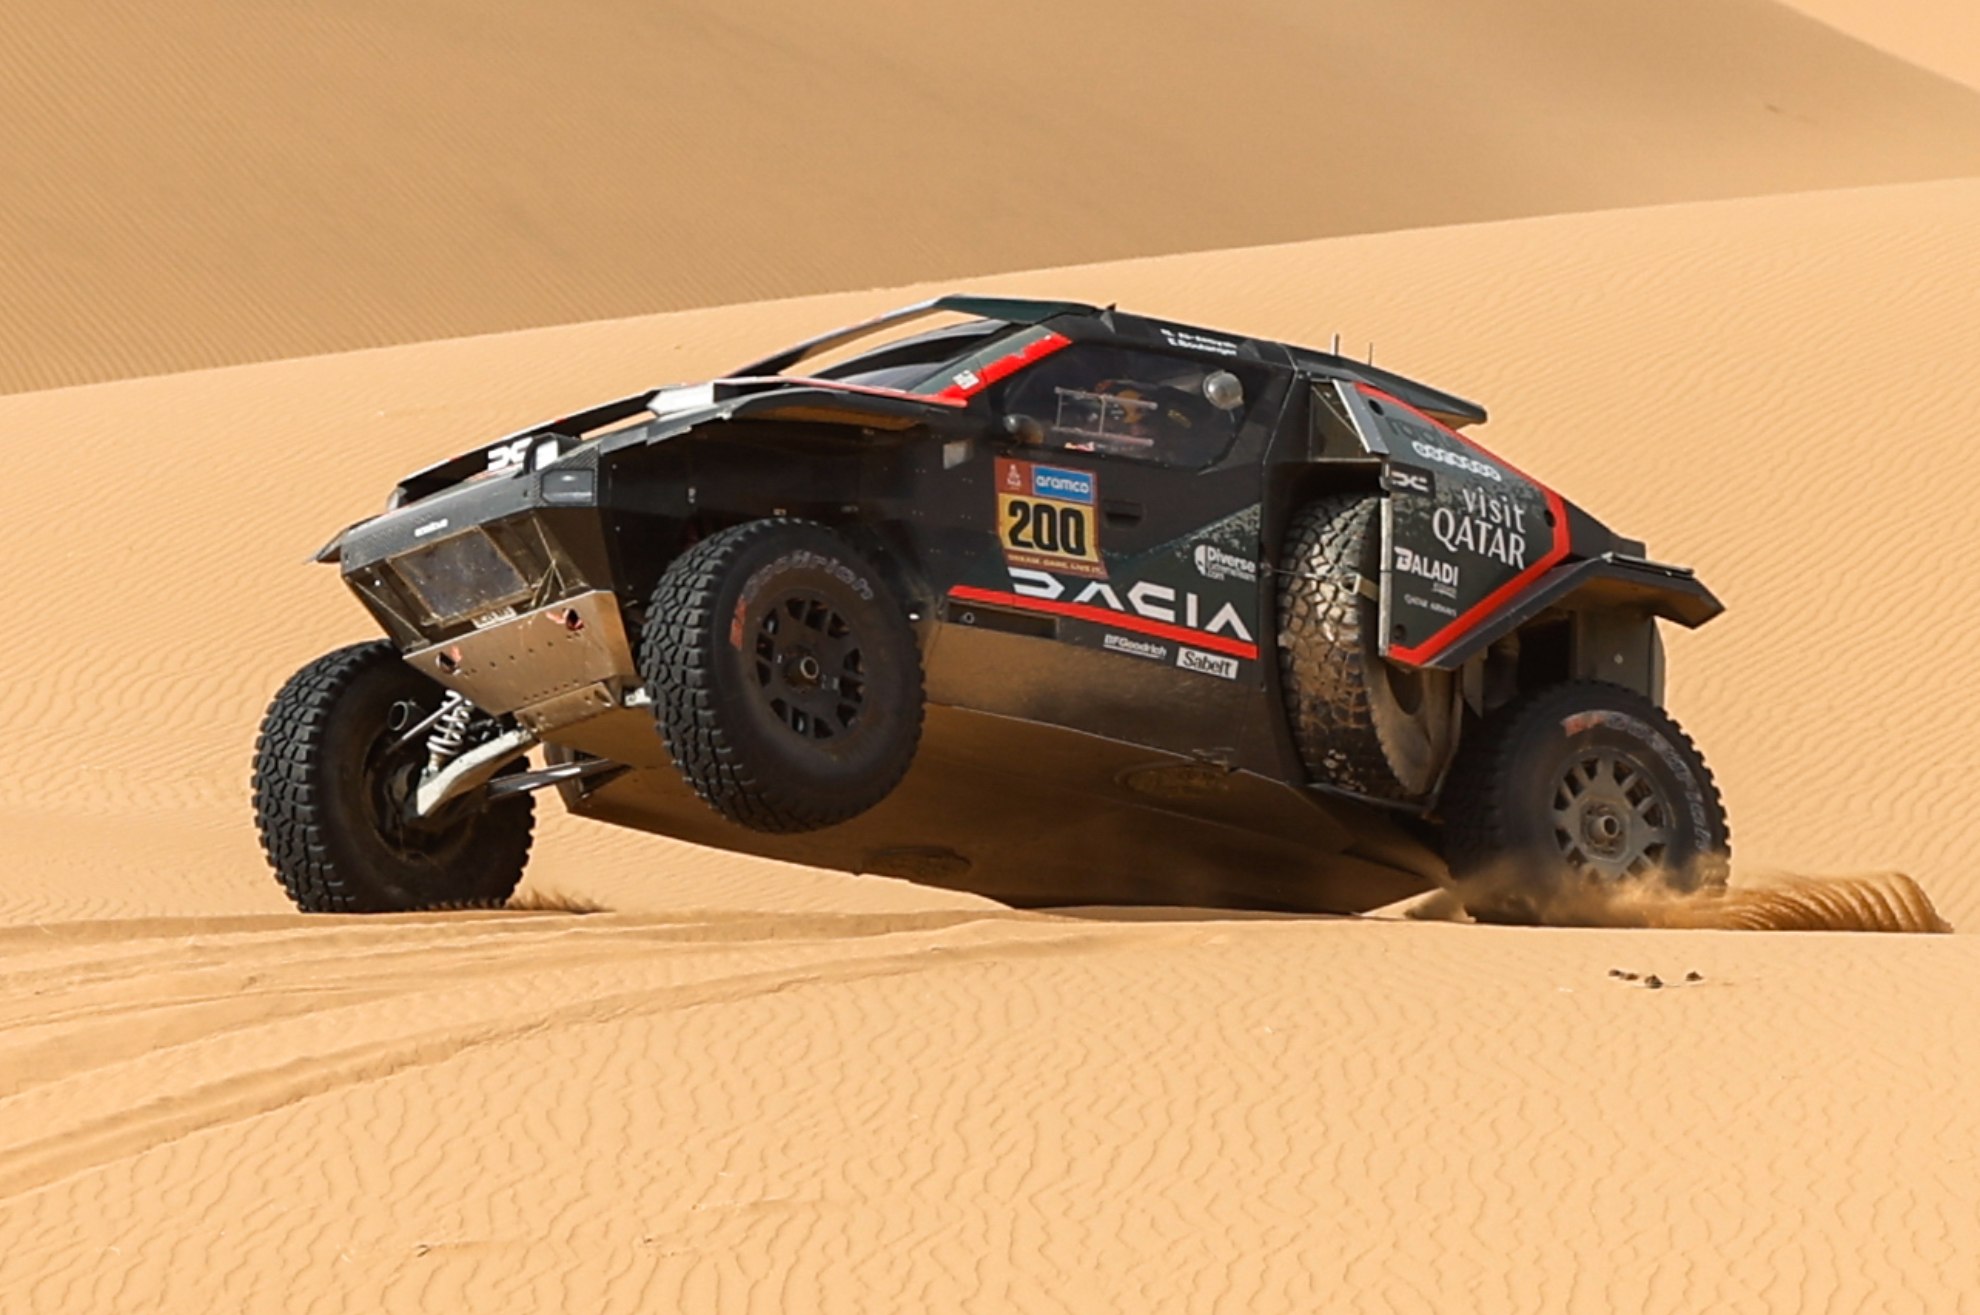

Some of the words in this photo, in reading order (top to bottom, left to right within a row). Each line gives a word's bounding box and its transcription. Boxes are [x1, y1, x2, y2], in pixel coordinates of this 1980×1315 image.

[1035, 475, 1091, 494] aramco
[1007, 500, 1087, 557] 200
[1462, 486, 1526, 534] visit
[1208, 546, 1256, 574] Diverse
[1432, 507, 1526, 571] QATAR
[1394, 546, 1459, 587] BALADI
[1007, 566, 1253, 641] DACIA
[1182, 651, 1233, 676] Sabelt
